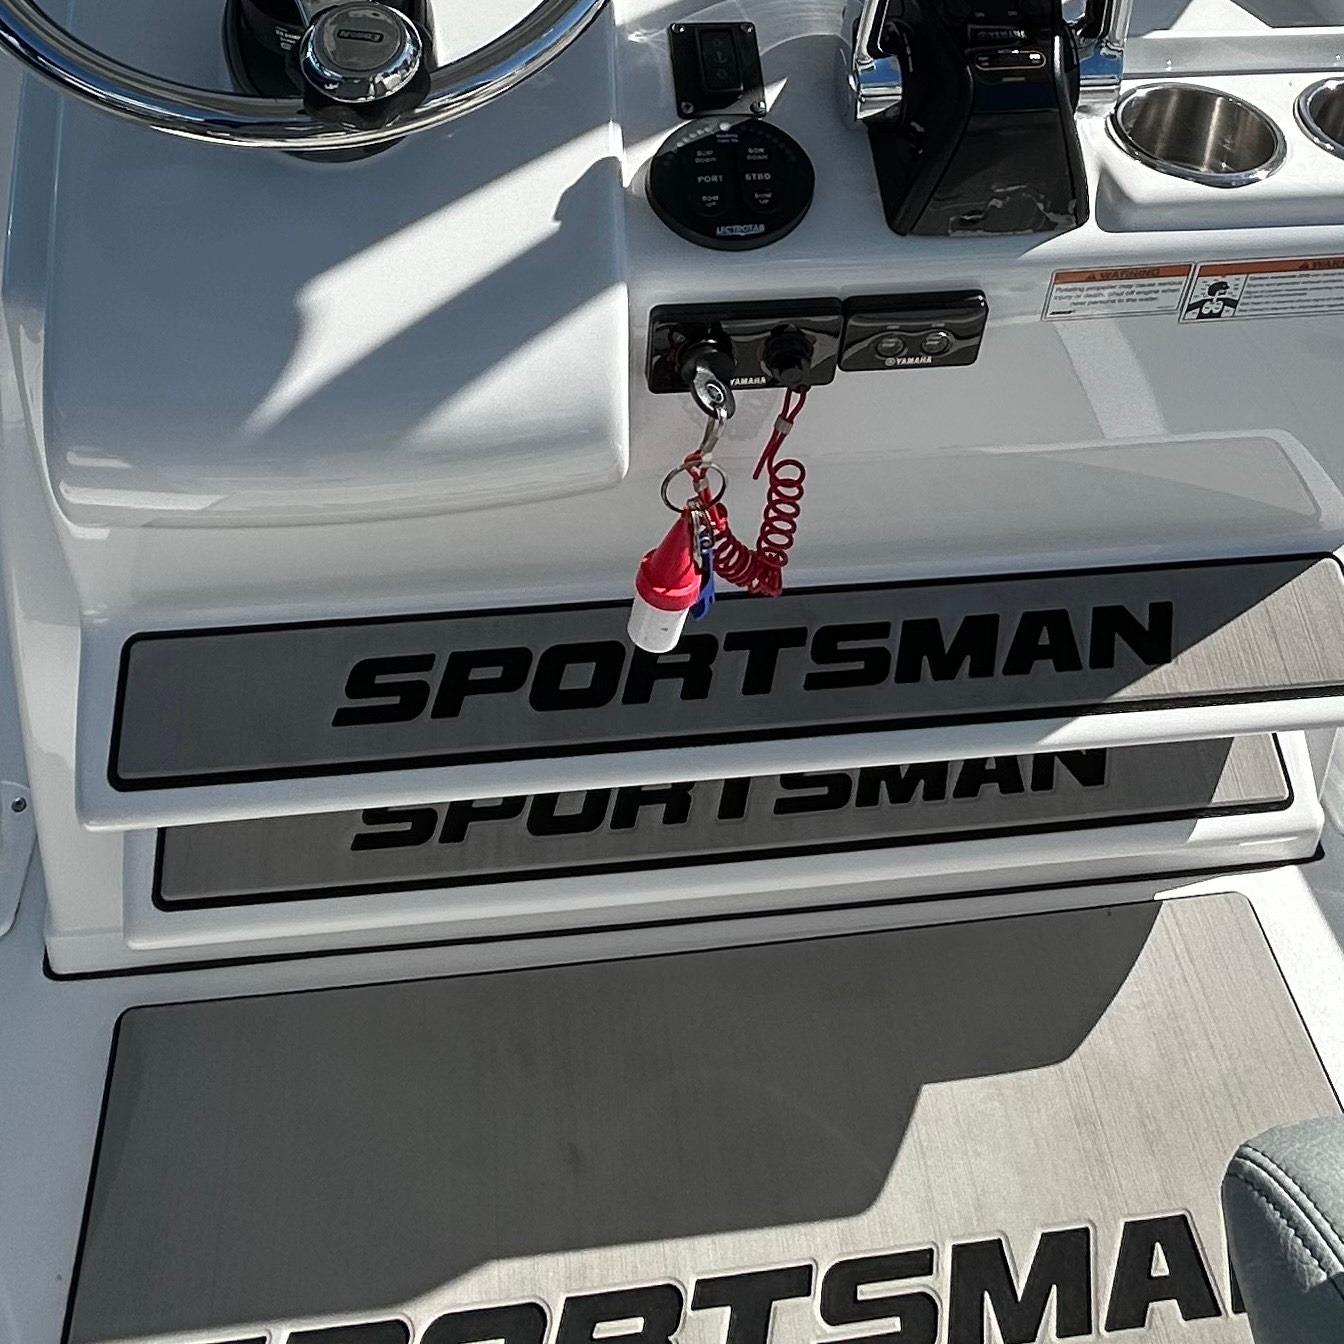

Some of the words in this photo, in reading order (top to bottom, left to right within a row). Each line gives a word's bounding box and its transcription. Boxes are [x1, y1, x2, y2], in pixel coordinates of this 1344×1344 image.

[697, 174, 723, 183] PORT
[745, 172, 771, 181] STBD
[1099, 267, 1160, 280] WARNING
[895, 355, 933, 366] YAMAHA
[729, 376, 767, 386] YAMAHA
[331, 600, 1174, 728] SPORTSMAN
[205, 1214, 1249, 1344] RTSMA
